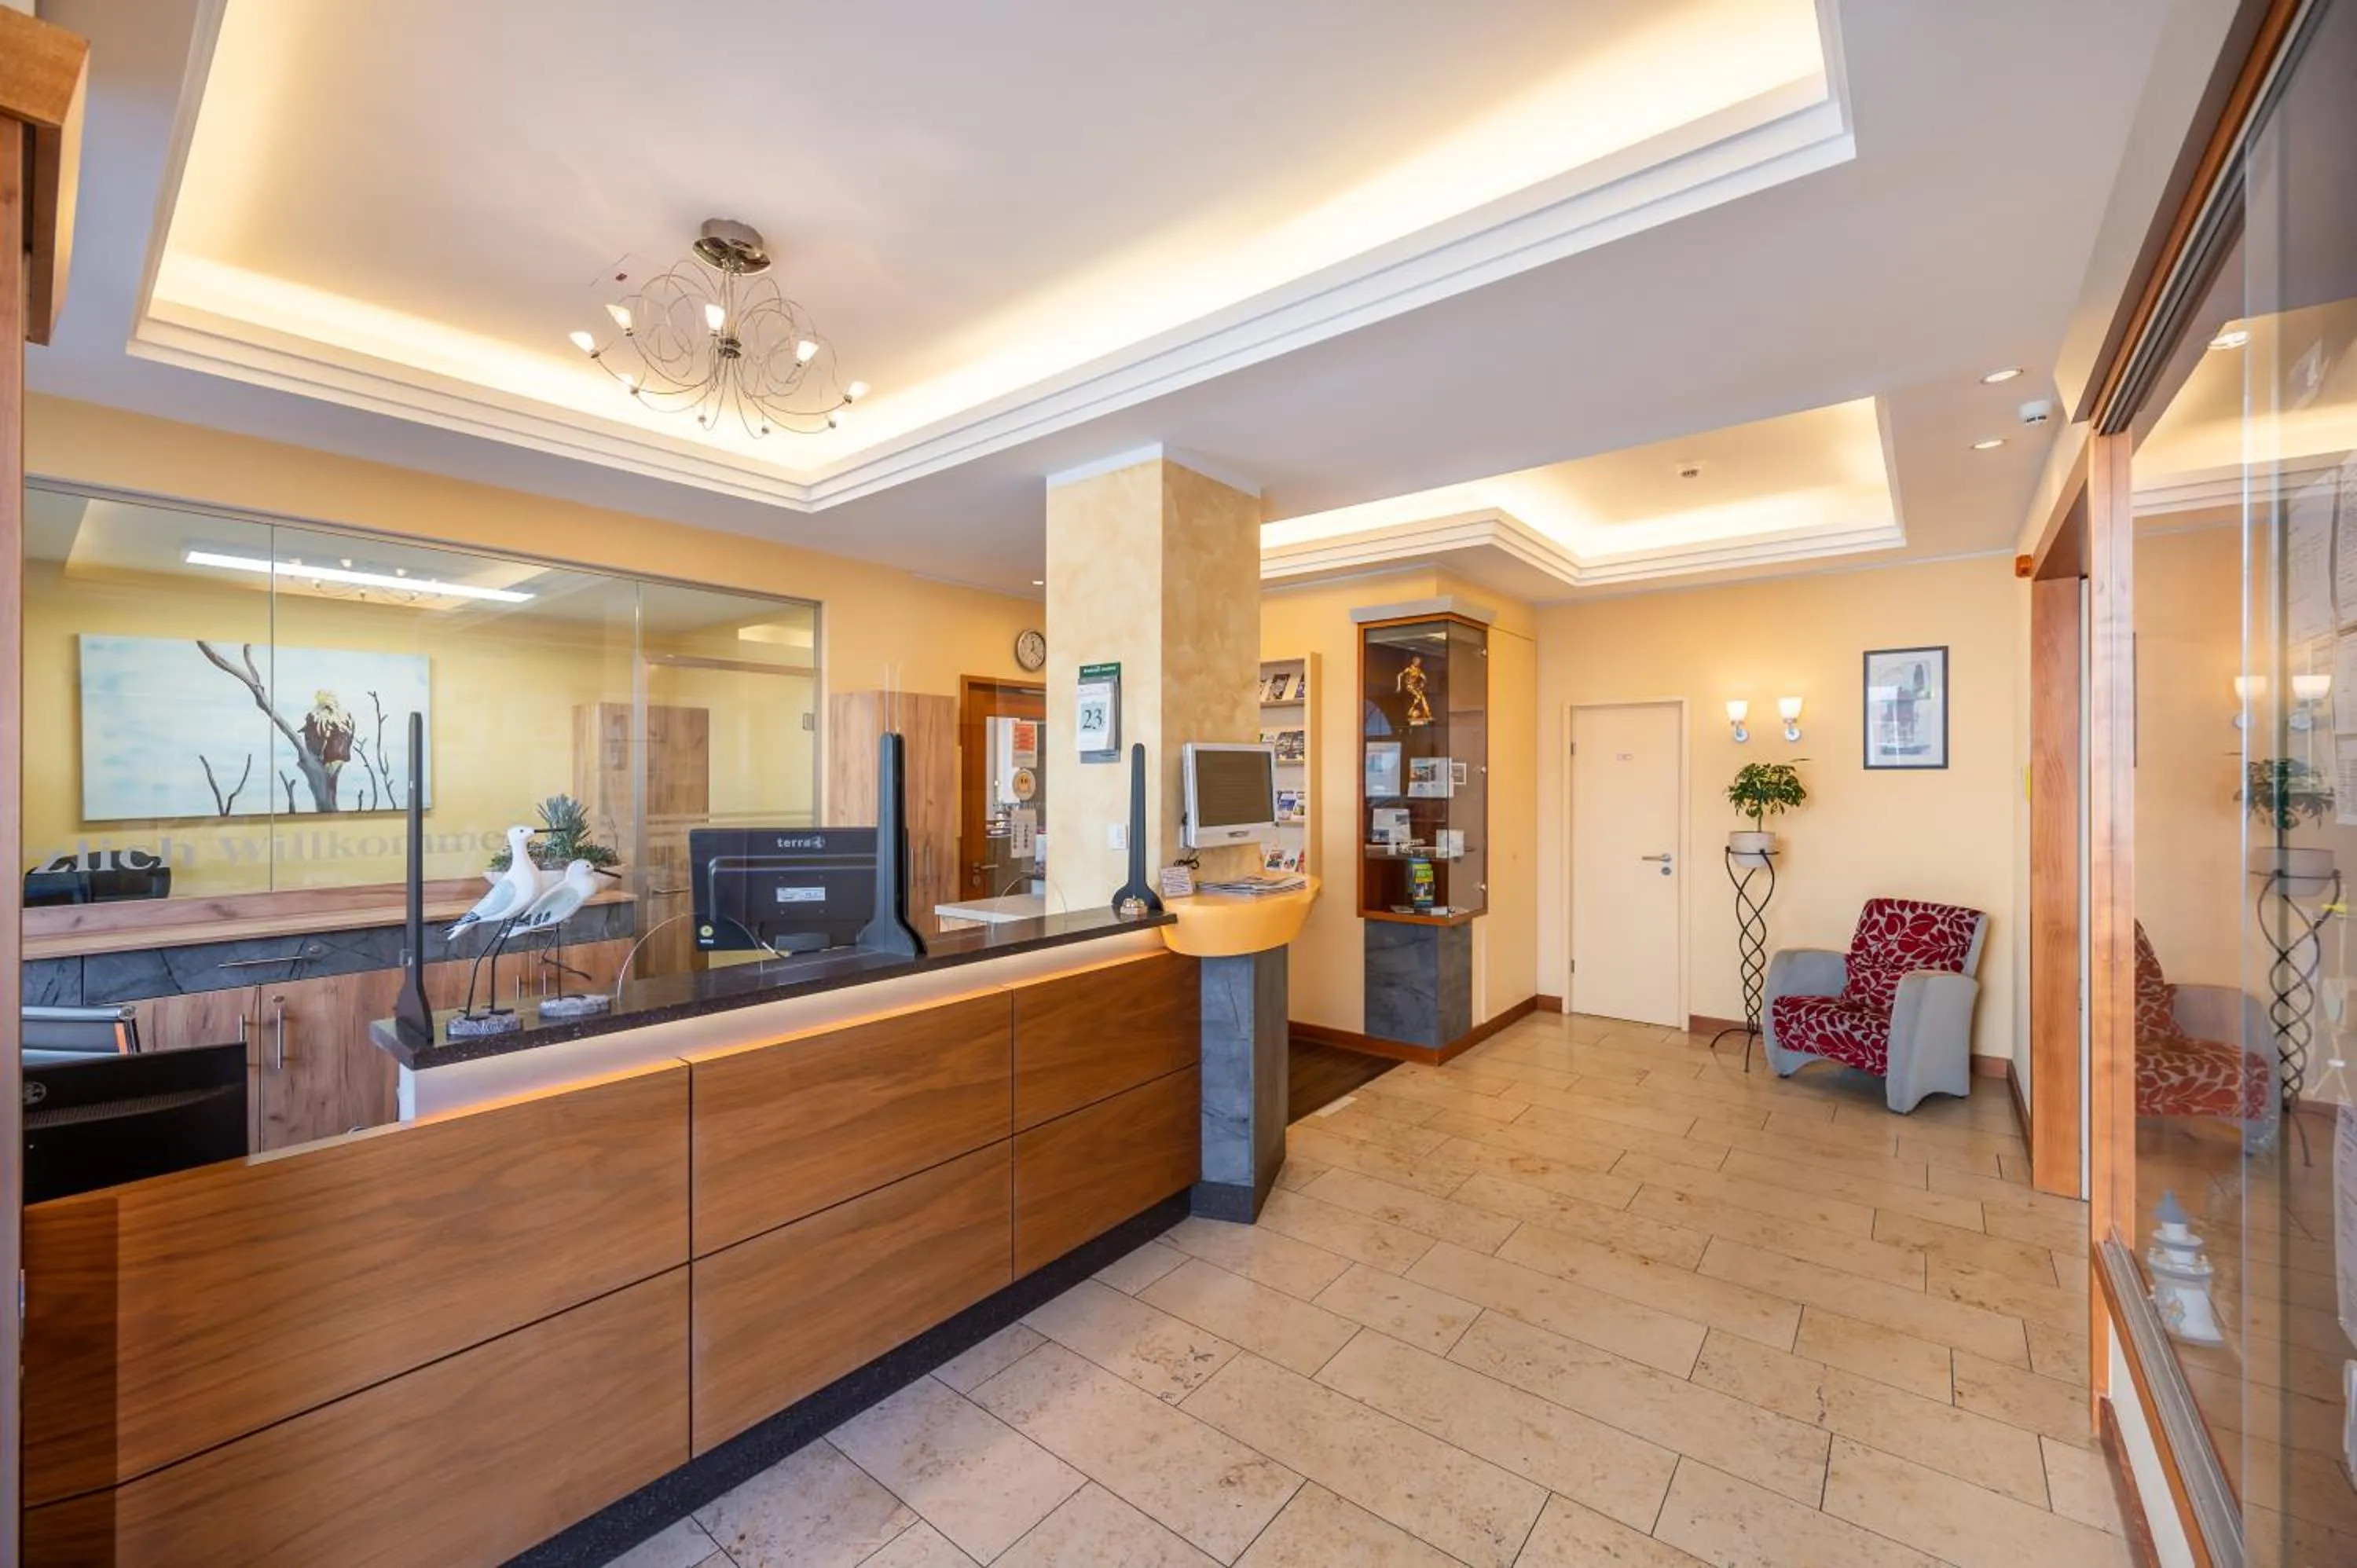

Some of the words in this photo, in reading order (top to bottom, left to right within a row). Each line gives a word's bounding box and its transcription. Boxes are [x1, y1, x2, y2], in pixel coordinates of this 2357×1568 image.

[1083, 708, 1103, 730] 23
[218, 830, 508, 865] Willkomme
[776, 837, 812, 848] terra
